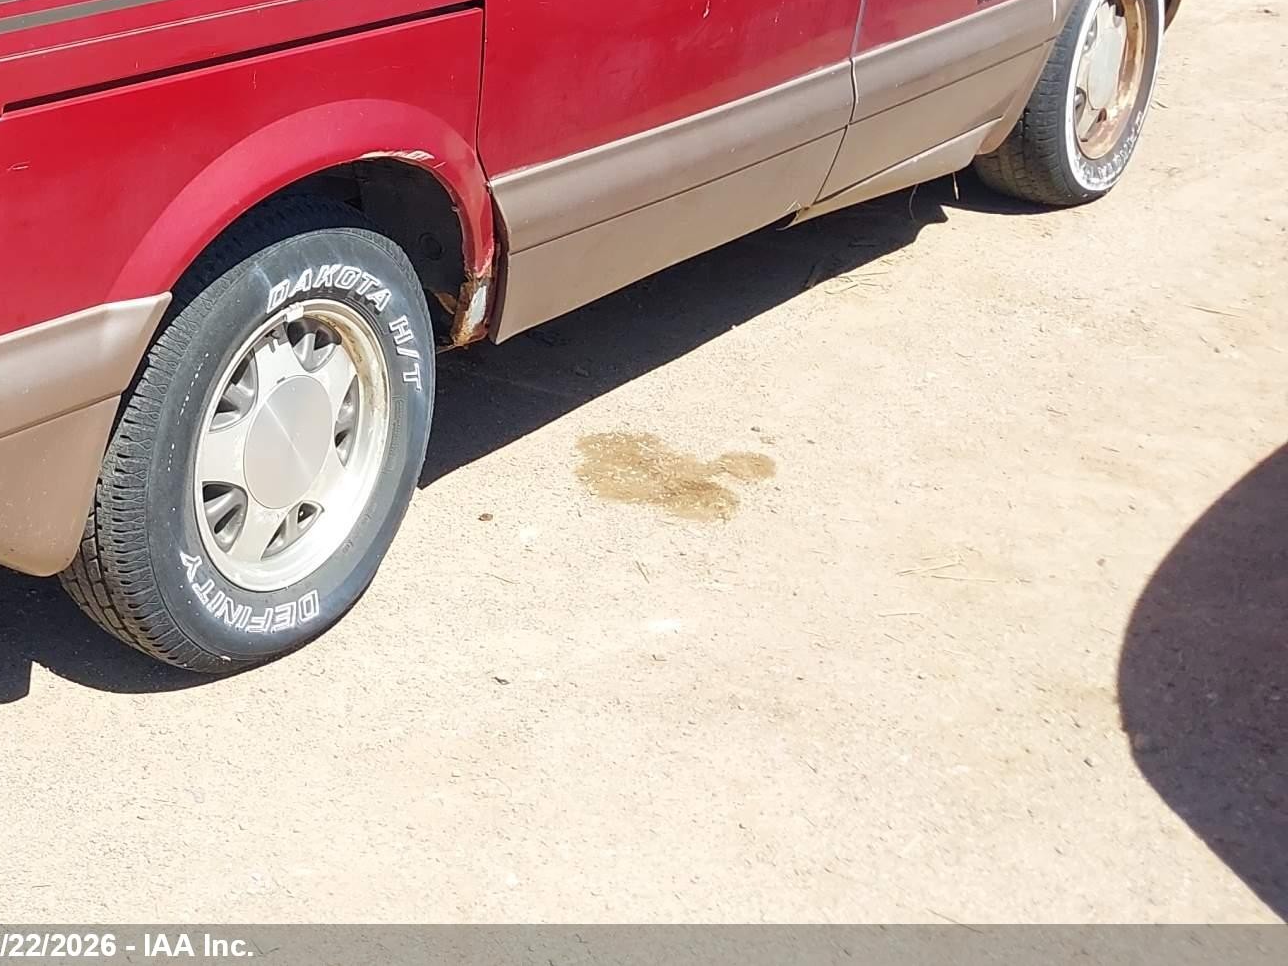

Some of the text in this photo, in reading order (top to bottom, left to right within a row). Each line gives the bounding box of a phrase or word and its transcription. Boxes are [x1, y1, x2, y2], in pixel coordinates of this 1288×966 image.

[267, 264, 423, 392] DAKOTA H/T
[180, 550, 320, 634] DEFINITY
